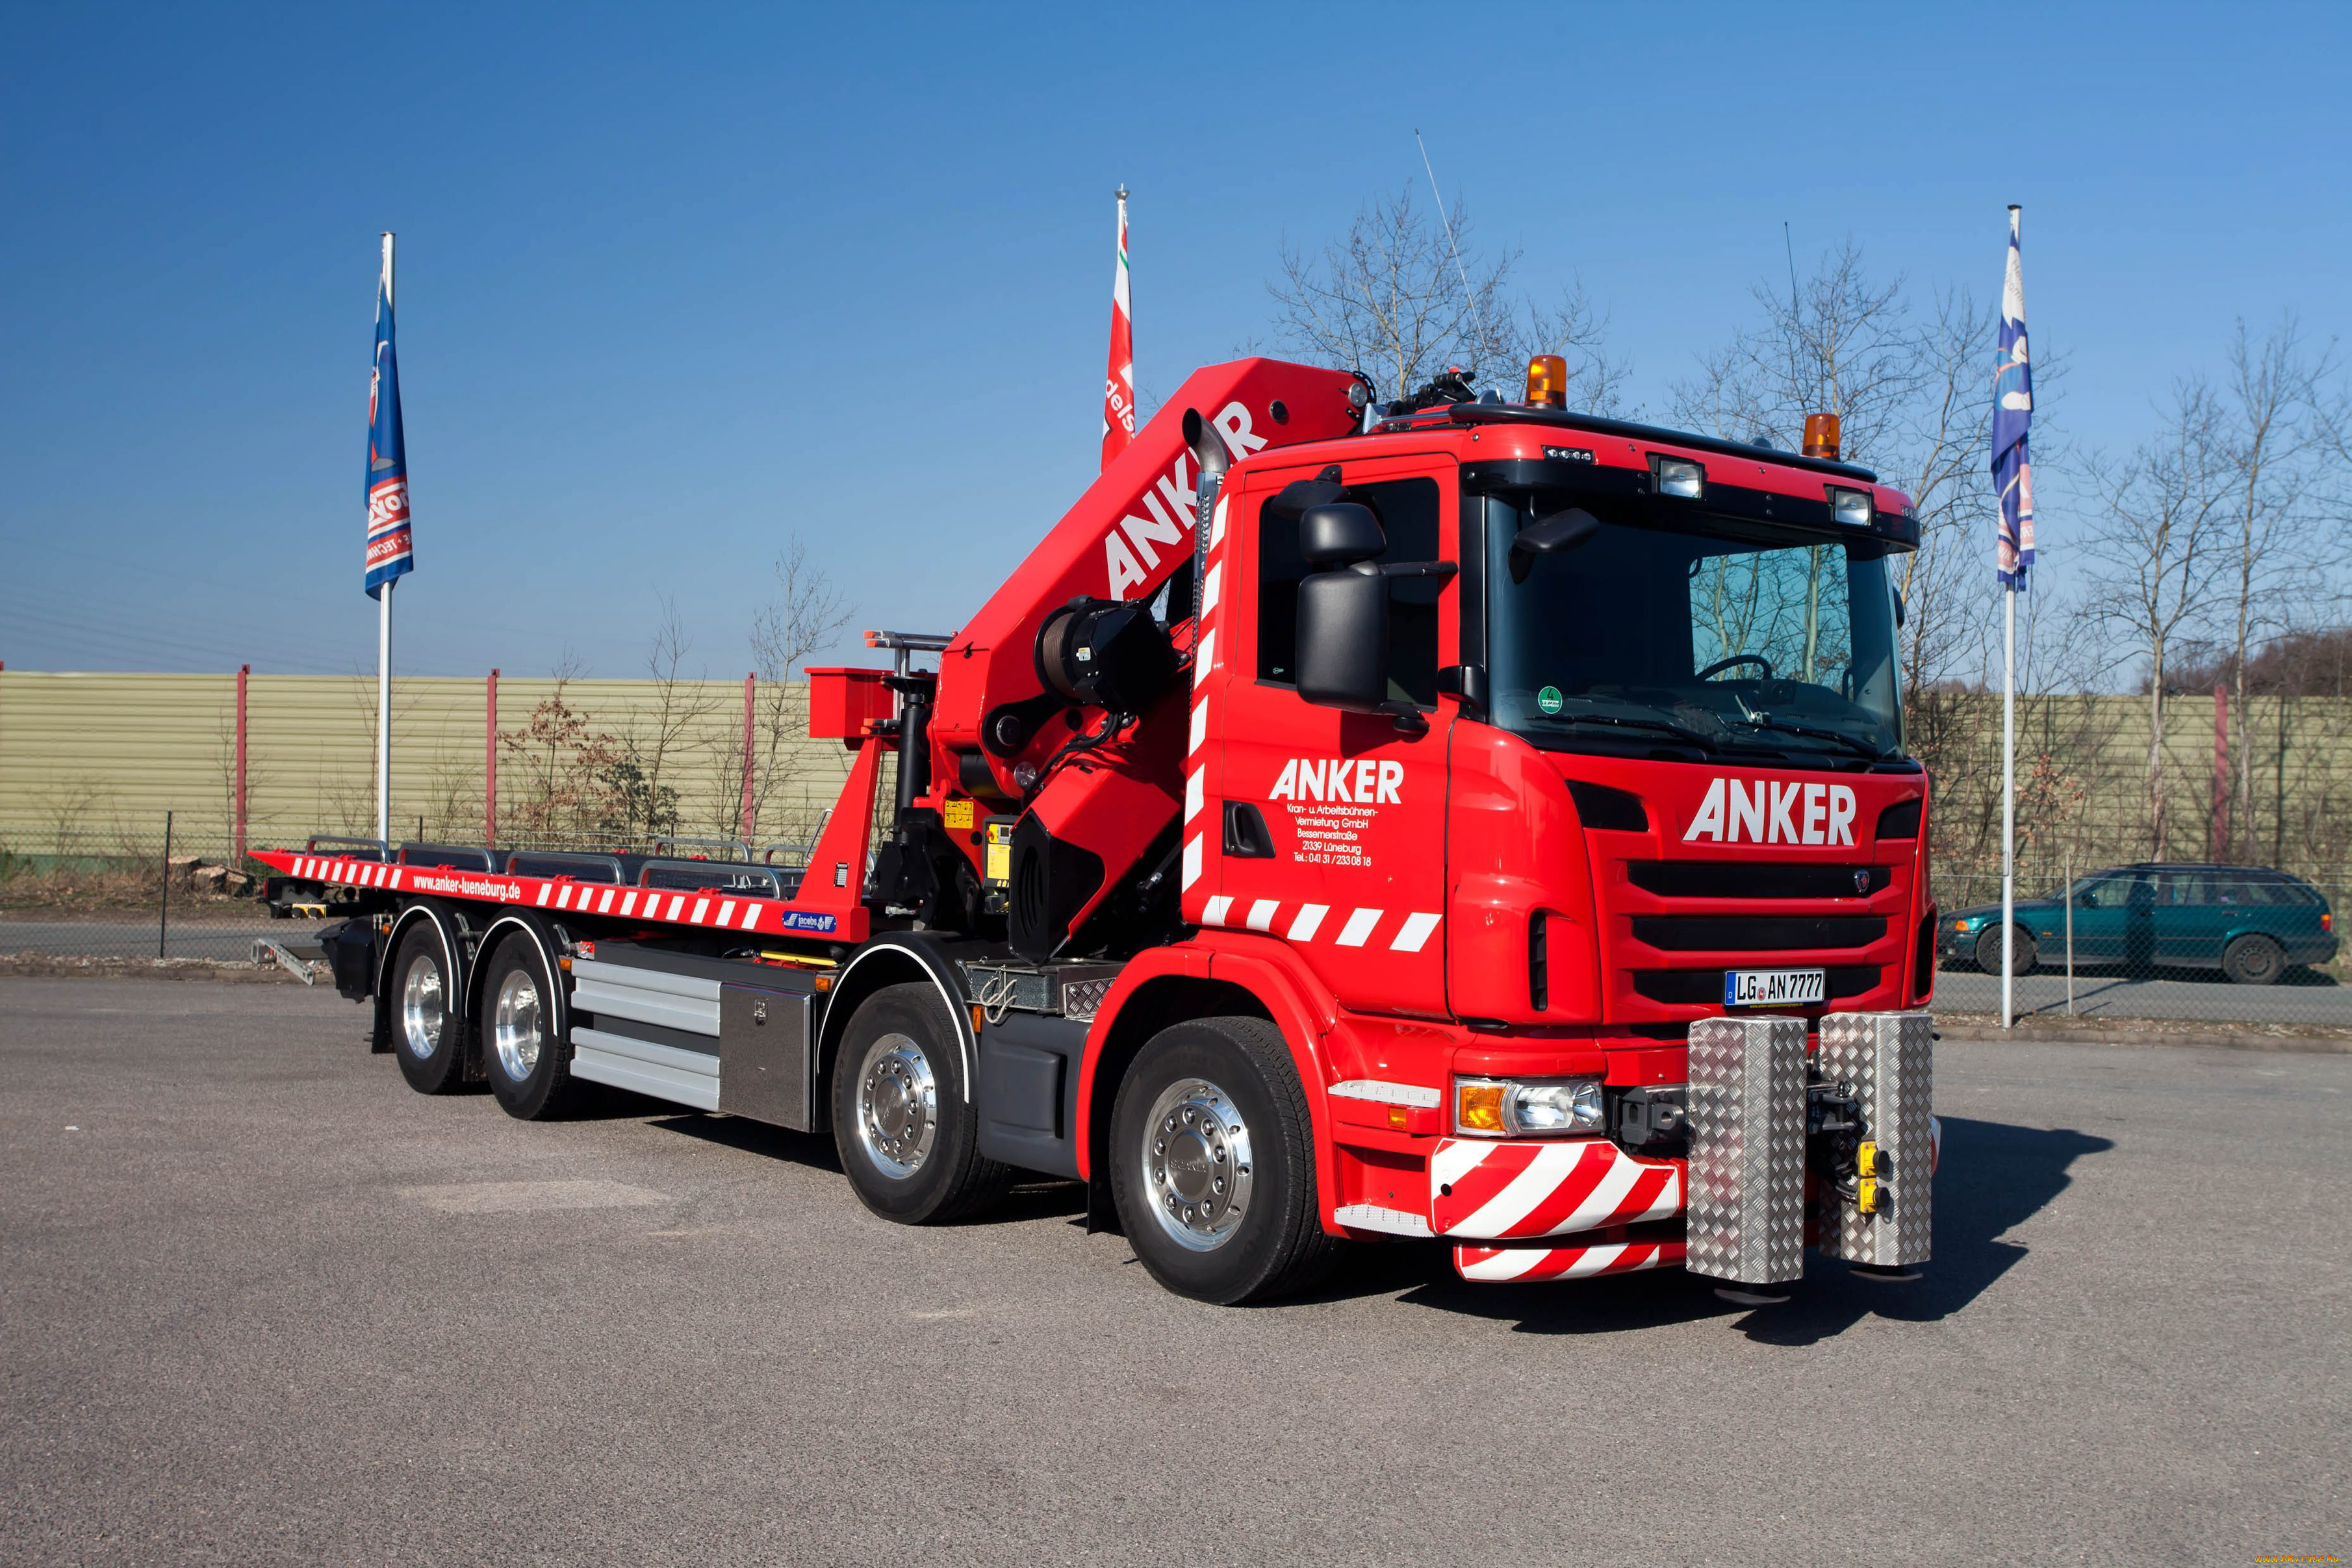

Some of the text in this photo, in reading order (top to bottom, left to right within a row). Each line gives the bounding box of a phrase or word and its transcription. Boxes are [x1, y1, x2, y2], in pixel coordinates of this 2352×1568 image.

[1106, 379, 1135, 439] dels
[1105, 401, 1268, 601] ANKR
[1546, 688, 1554, 700] 4
[1268, 758, 1404, 804] ANKER
[1286, 803, 1307, 813] Kran-
[1316, 805, 1378, 816] Arbeitsbühnen-
[1682, 778, 1856, 846] ANKER
[1295, 816, 1369, 829] Vermietung GmbH
[1297, 828, 1358, 841] Bessemerstraße
[1302, 841, 1362, 855] 21339 Lüneburg
[413, 875, 520, 902] www.anker-lueneburg.de
[798, 913, 817, 928] jacobs
[1737, 976, 1757, 1000] LG
[1767, 975, 1786, 999] AN
[1789, 973, 1822, 998] 7777
